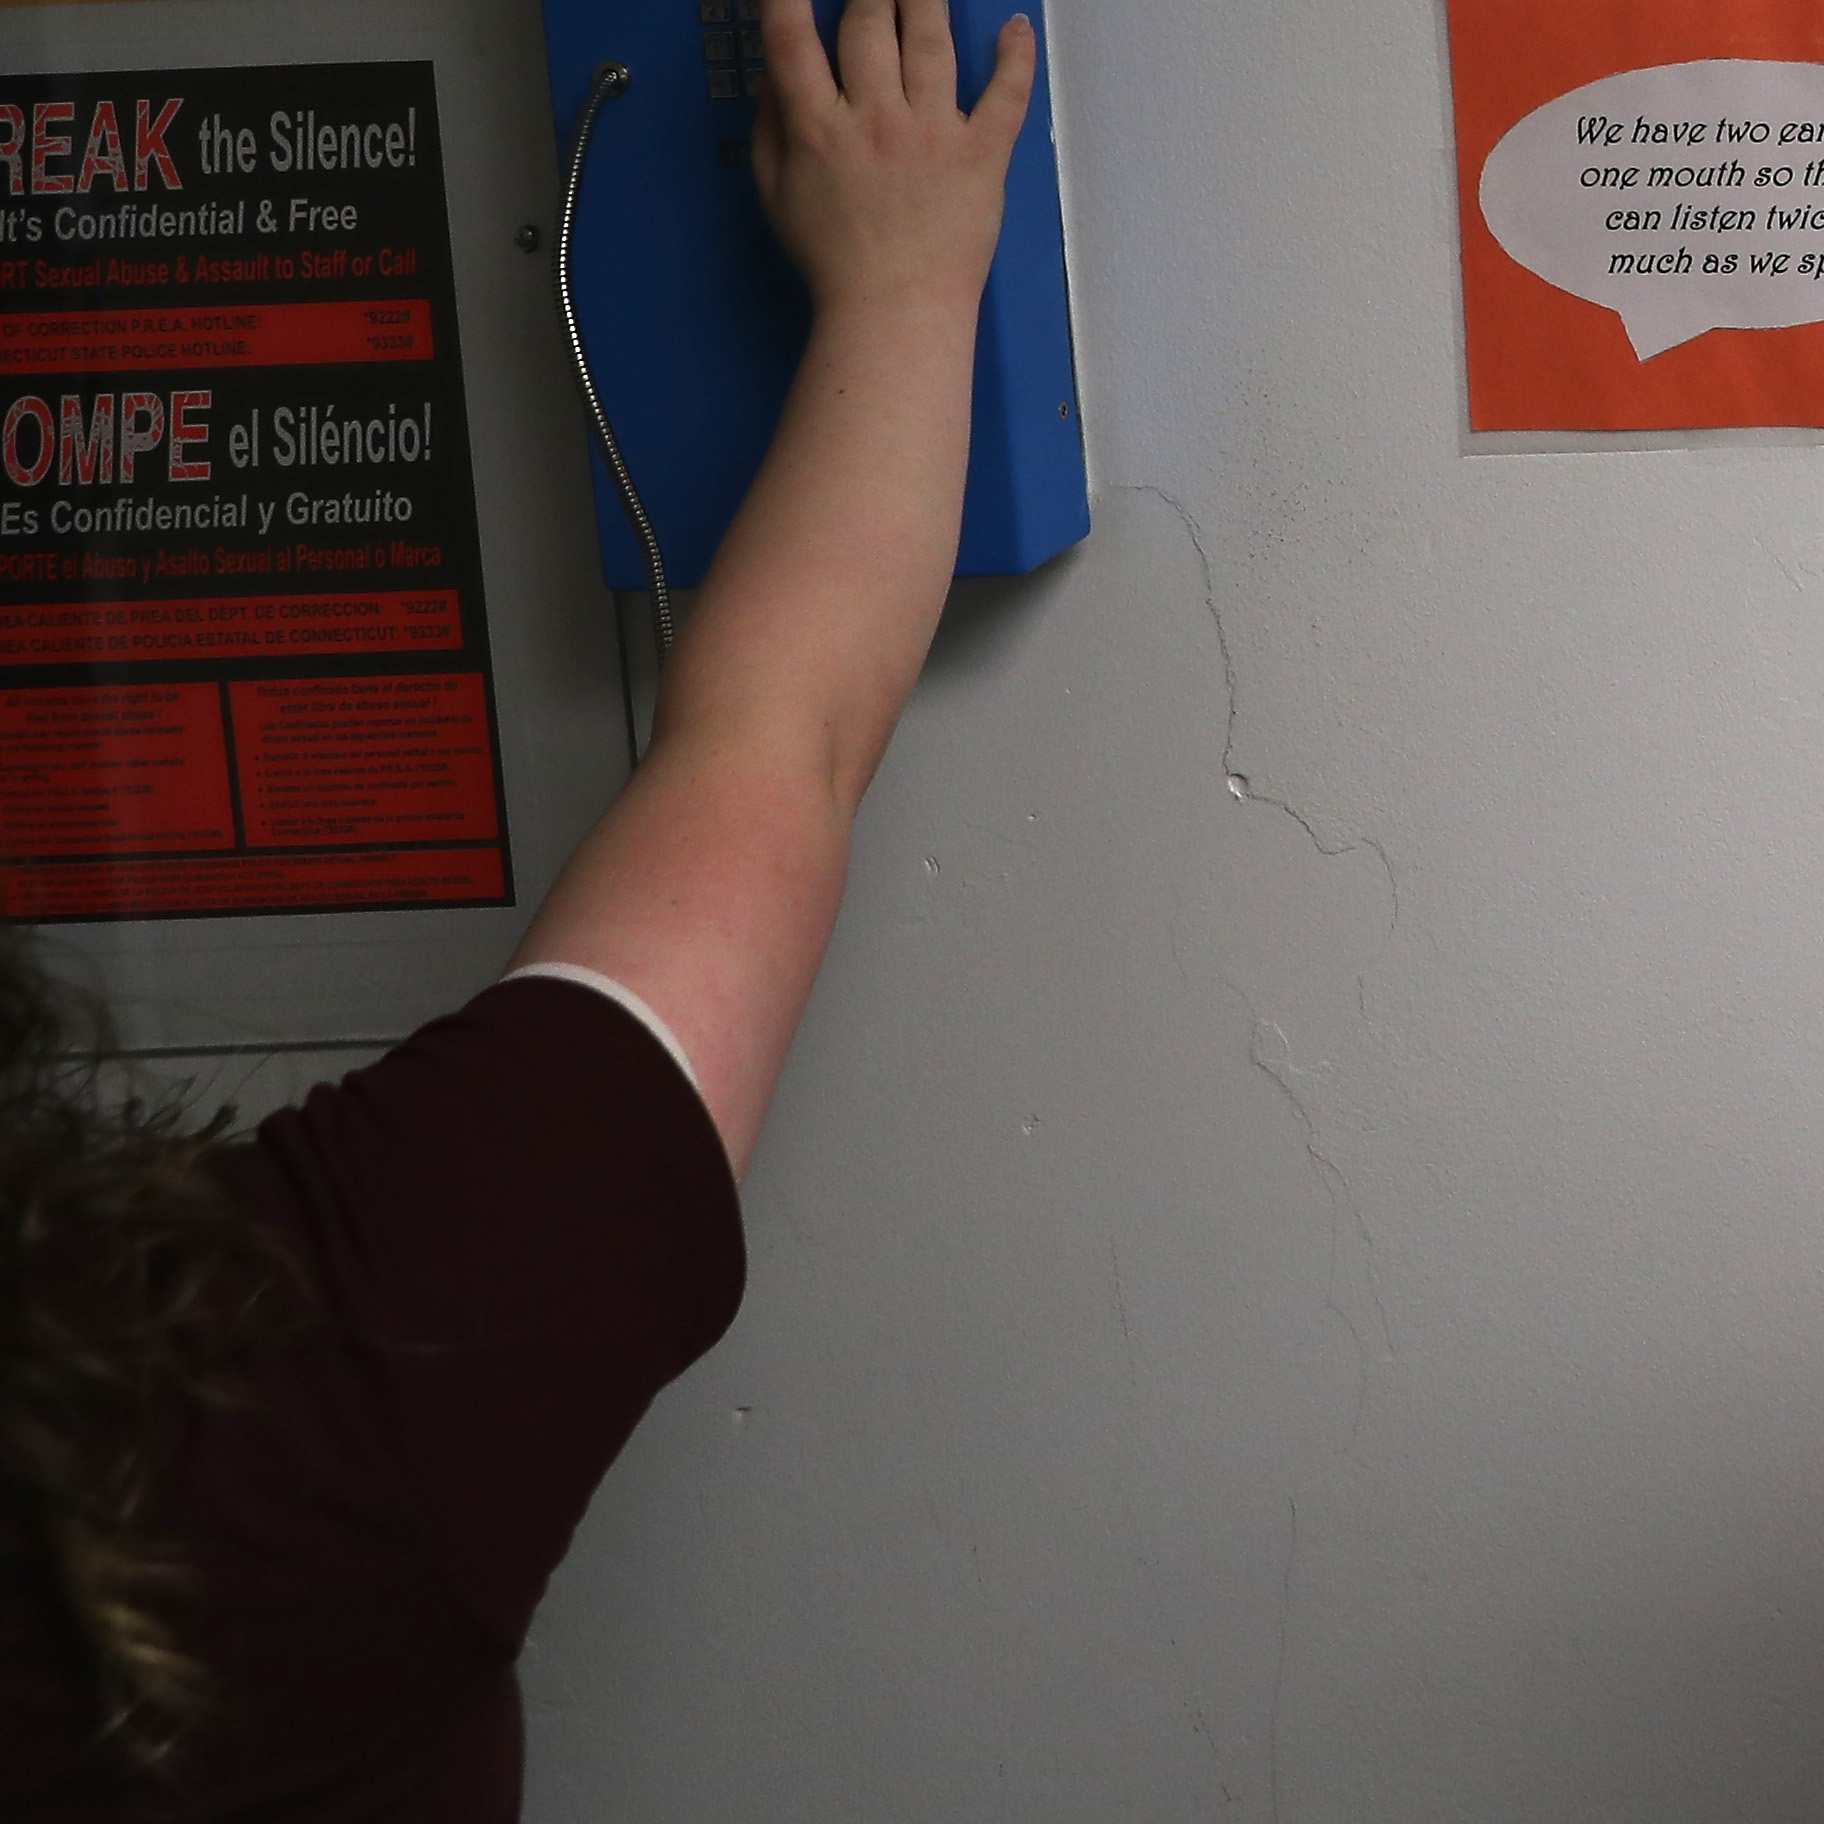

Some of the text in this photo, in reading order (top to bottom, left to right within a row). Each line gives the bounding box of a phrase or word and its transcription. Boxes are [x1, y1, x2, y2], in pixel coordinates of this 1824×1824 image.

[198, 107, 415, 174] the Silence!
[1578, 116, 1624, 147] We
[1631, 116, 1707, 146] have
[1716, 118, 1770, 143] two
[1580, 167, 1640, 190] one
[1647, 159, 1745, 187] mouth
[1754, 167, 1793, 187] so
[54, 201, 244, 240] Confidential
[256, 199, 278, 233] &
[289, 198, 357, 232] Free
[1606, 211, 1661, 230] can
[1670, 203, 1756, 233] listen
[1608, 246, 1692, 274] much
[1702, 254, 1738, 274] as
[1750, 252, 1791, 277] we
[229, 402, 431, 468] el Siléncio!
[1, 489, 412, 535] Es Confidencial y Gratuito
